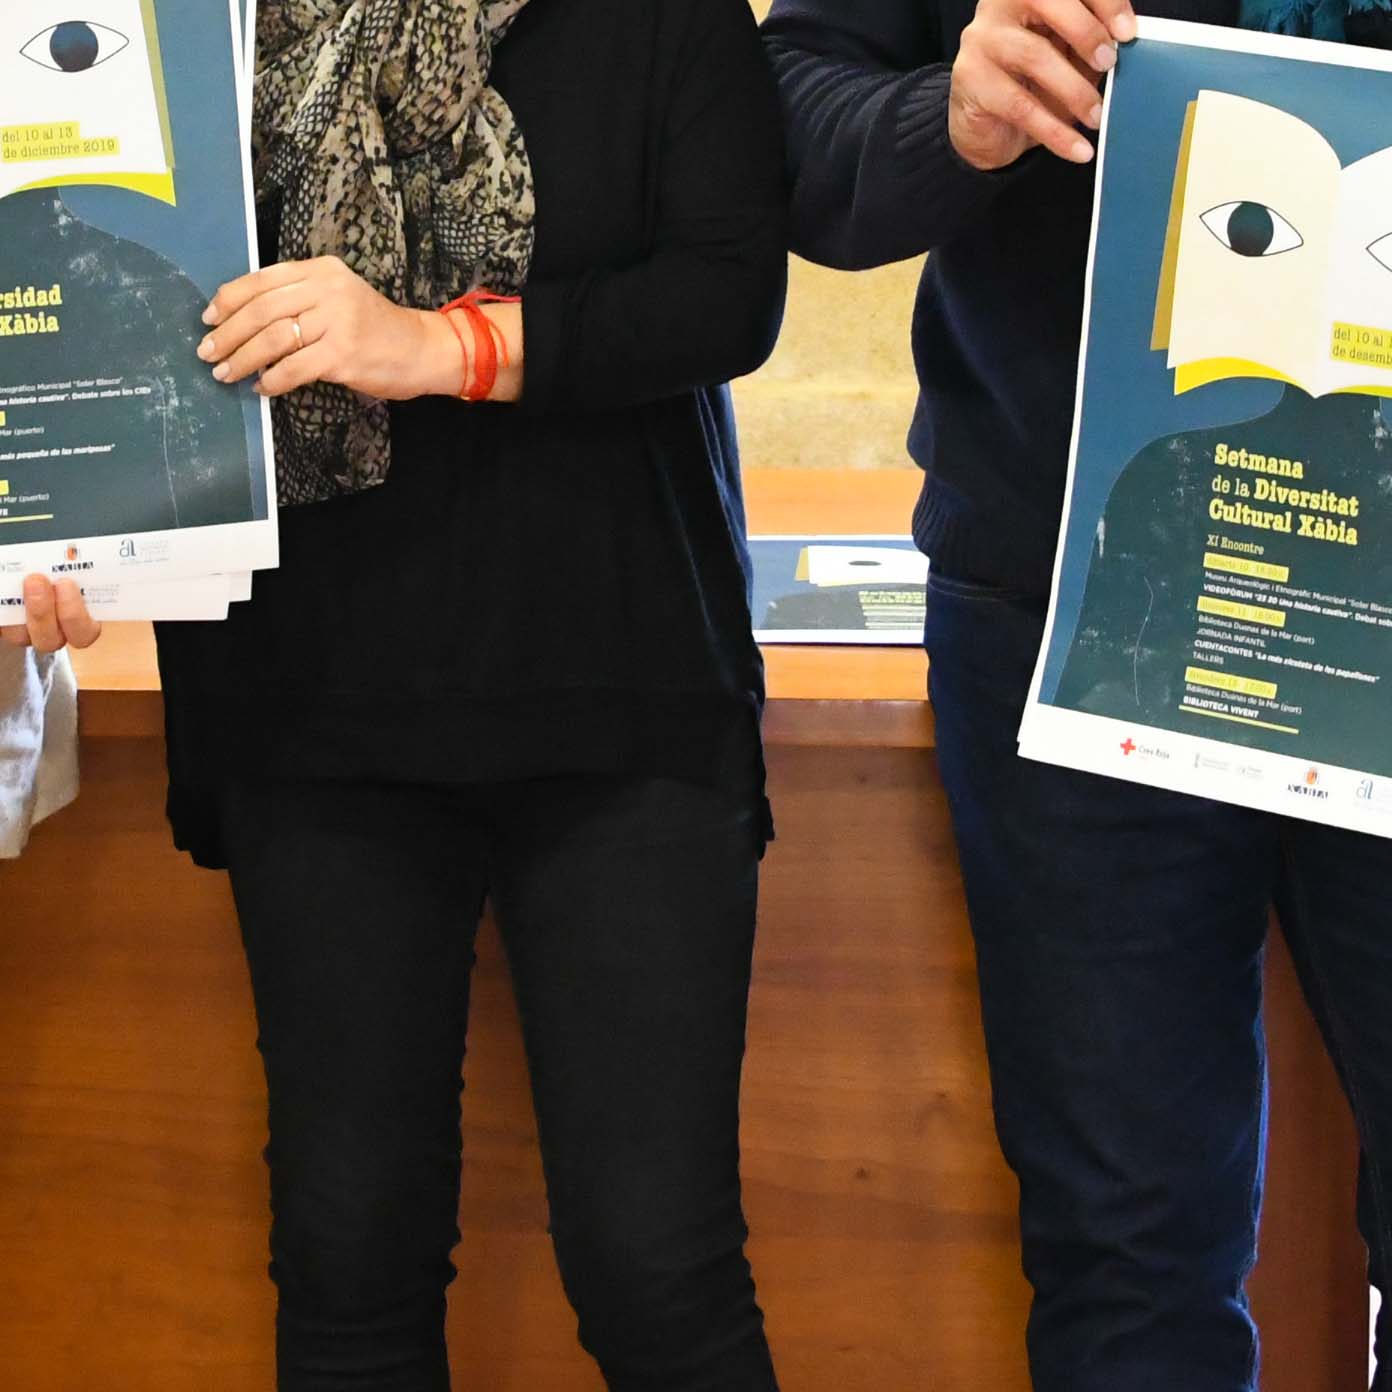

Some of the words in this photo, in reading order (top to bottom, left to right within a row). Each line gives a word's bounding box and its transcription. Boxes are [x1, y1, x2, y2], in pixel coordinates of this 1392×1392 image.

[2, 130, 19, 143] del
[26, 129, 39, 142] 10
[42, 128, 53, 140] al
[59, 126, 73, 138] 13
[3, 146, 17, 159] de
[21, 143, 80, 158] diciembre
[83, 139, 115, 153] 2019
[1334, 328, 1350, 341] del
[1356, 331, 1369, 344] 10
[1373, 335, 1383, 347] al
[1332, 345, 1346, 356] de
[1214, 443, 1303, 479] Setmana
[1212, 474, 1230, 494] de
[1234, 478, 1250, 497] la
[1254, 478, 1359, 517] Diversitat
[1209, 498, 1292, 533] Cultural
[1297, 513, 1358, 545] Xàbia
[1206, 534, 1219, 546] XI
[1221, 537, 1264, 555] Encontre
[1197, 627, 1232, 640] JORNADA
[1192, 651, 1224, 665] TALLERS
[1194, 639, 1253, 658] CUENTACONTES
[1183, 695, 1229, 712] BIBLIOTECA
[1230, 705, 1259, 719] VIVENT
